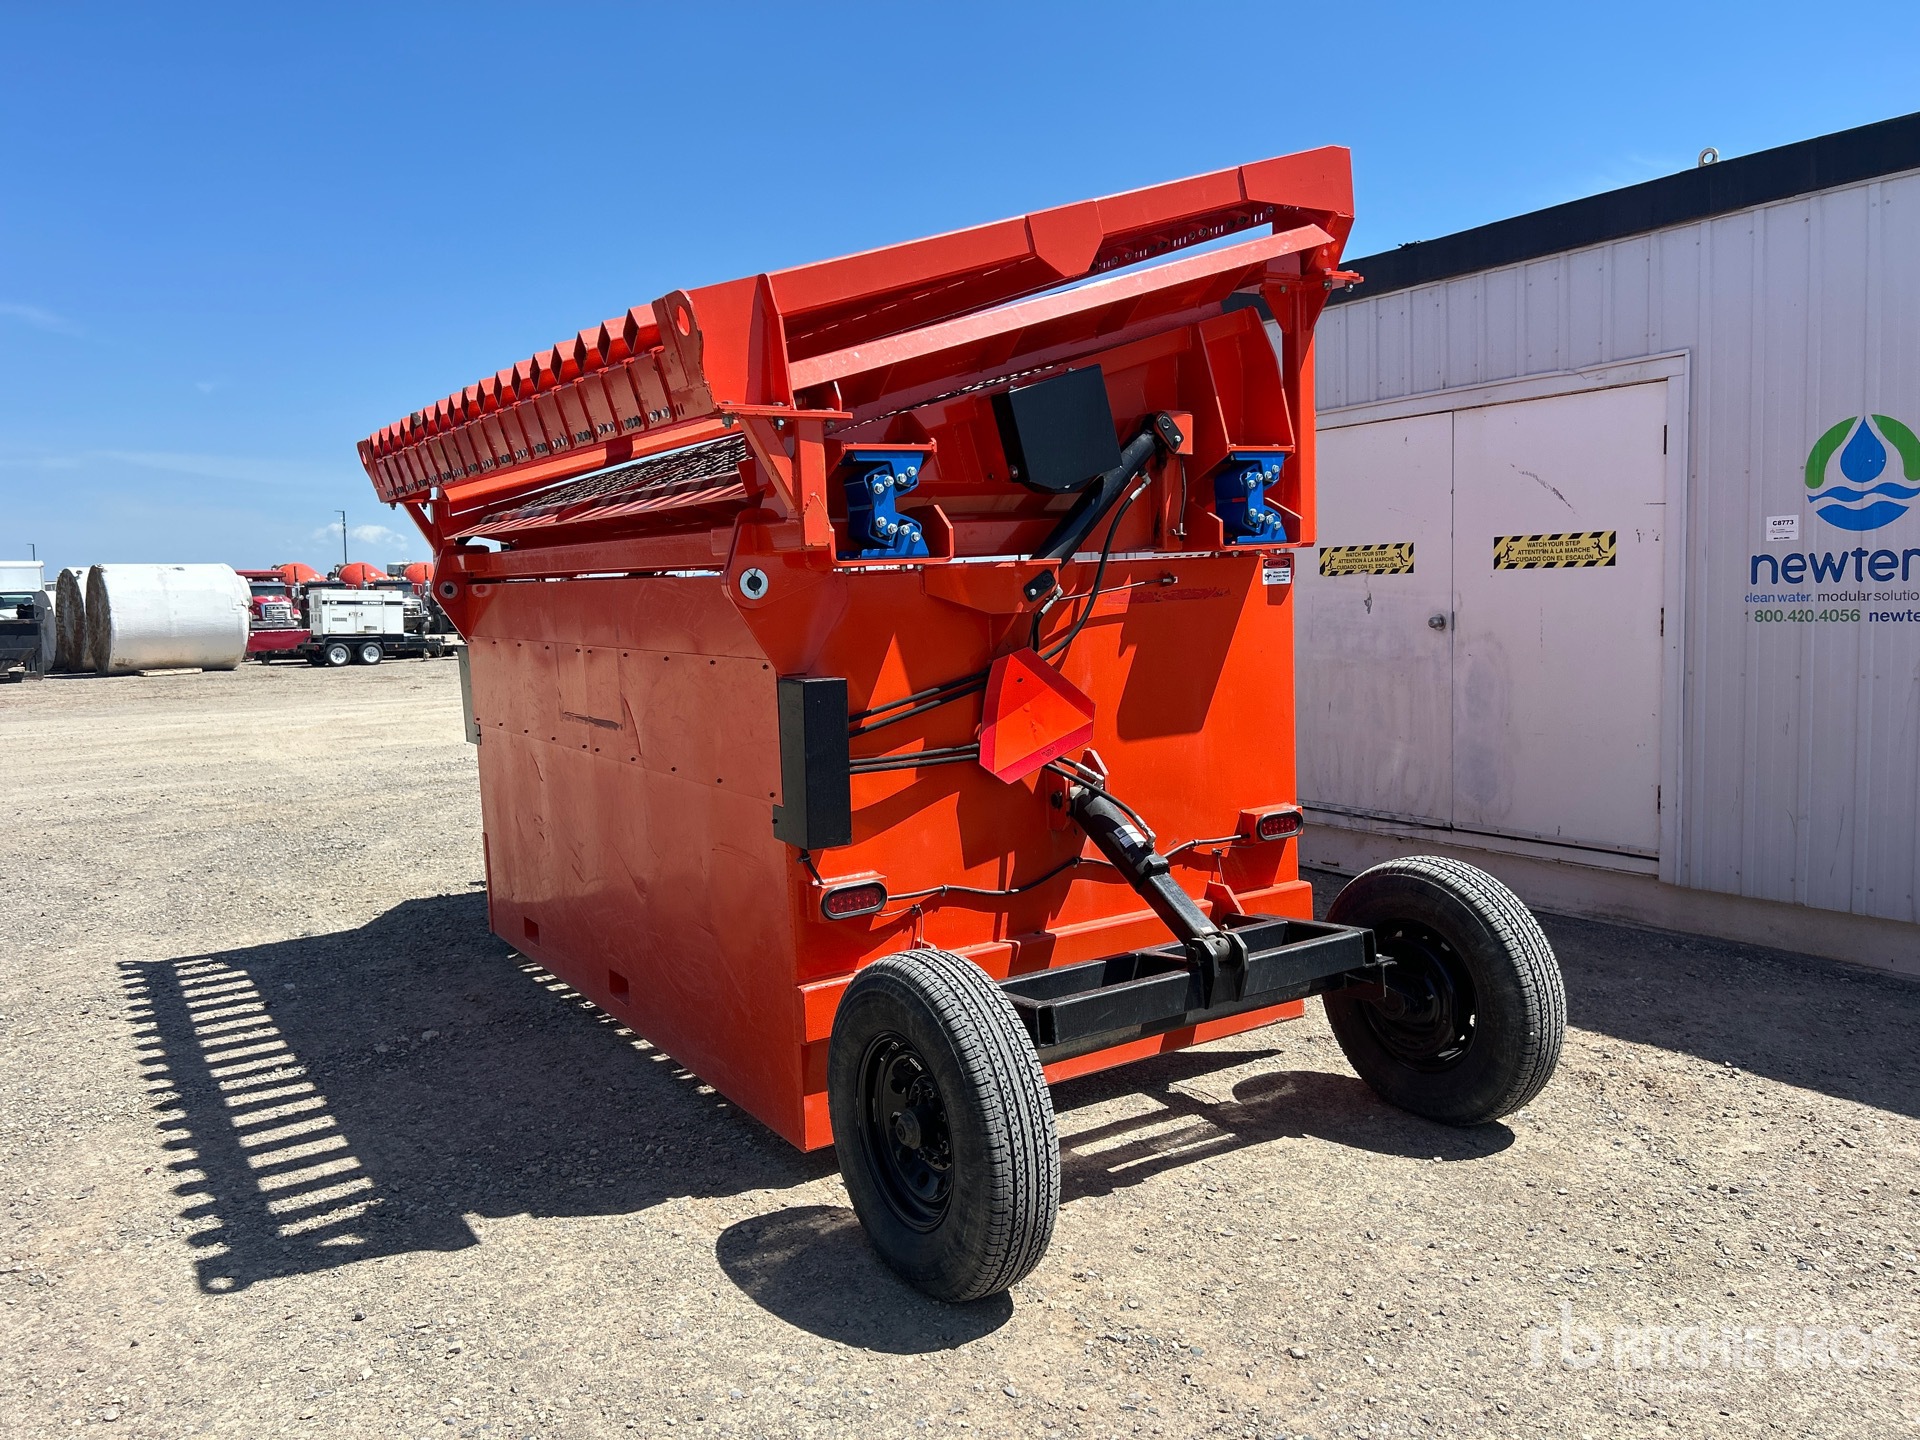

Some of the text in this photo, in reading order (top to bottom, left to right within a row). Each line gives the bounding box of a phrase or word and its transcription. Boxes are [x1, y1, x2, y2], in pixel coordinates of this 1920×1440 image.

[1338, 557, 1362, 565] ATTENTION
[1515, 555, 1541, 563] CUIDADO
[1565, 553, 1594, 561] ESCALÓN
[1744, 589, 1920, 602] clean water. modular solutio
[1754, 608, 1861, 622] 800.420.4056
[1868, 609, 1920, 622] newte
